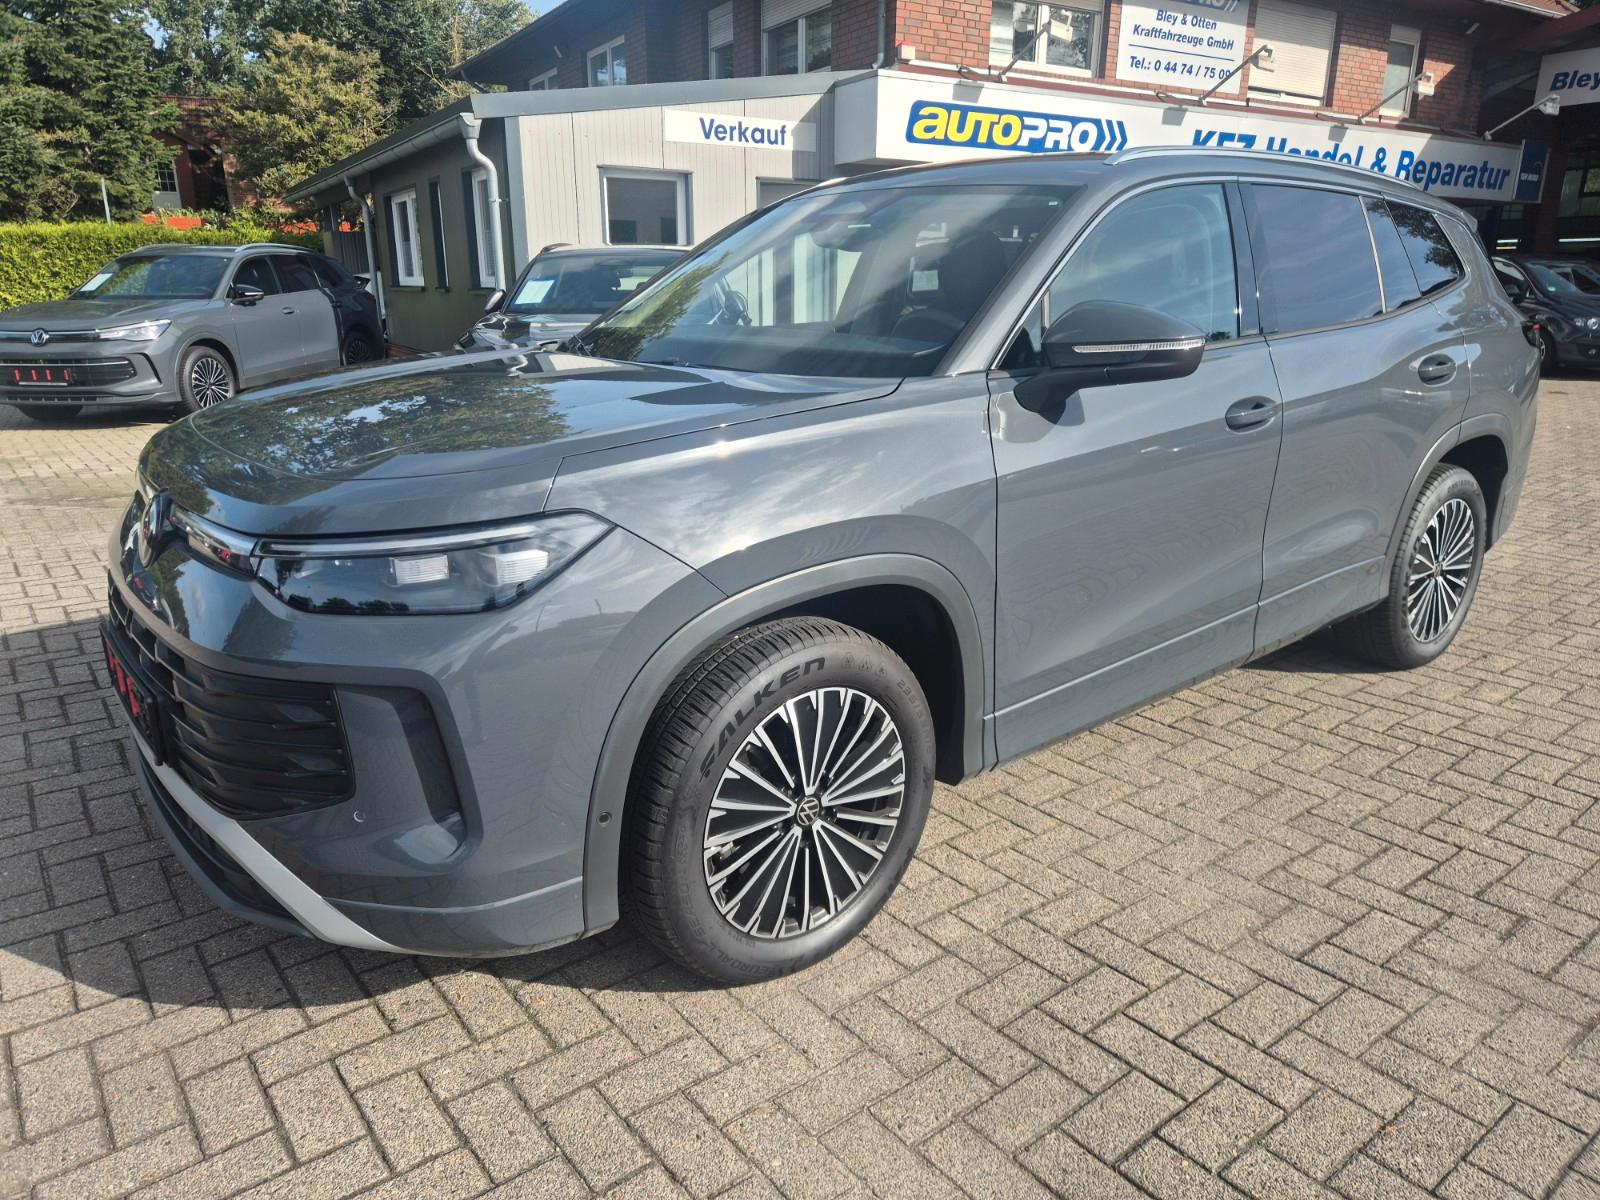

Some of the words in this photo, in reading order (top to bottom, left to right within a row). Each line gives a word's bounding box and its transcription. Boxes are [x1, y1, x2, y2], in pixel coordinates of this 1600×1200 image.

[1156, 9, 1178, 26] Bley
[1181, 13, 1187, 26] &
[1191, 15, 1217, 31] Otten
[1132, 23, 1204, 48] Kraftfahrzeuge
[1207, 36, 1234, 51] GmbH
[1129, 55, 1151, 71] Tel.:
[1154, 59, 1161, 72] 0
[1164, 61, 1177, 74] 44
[1180, 63, 1193, 76] 74
[1195, 65, 1202, 77] /
[1204, 66, 1216, 79] 75
[1550, 69, 1600, 92] Bley
[699, 117, 787, 146] Verkauf
[1370, 146, 1388, 173] &
[1395, 150, 1511, 192] Reparatur
[699, 657, 826, 782] FALKEN
